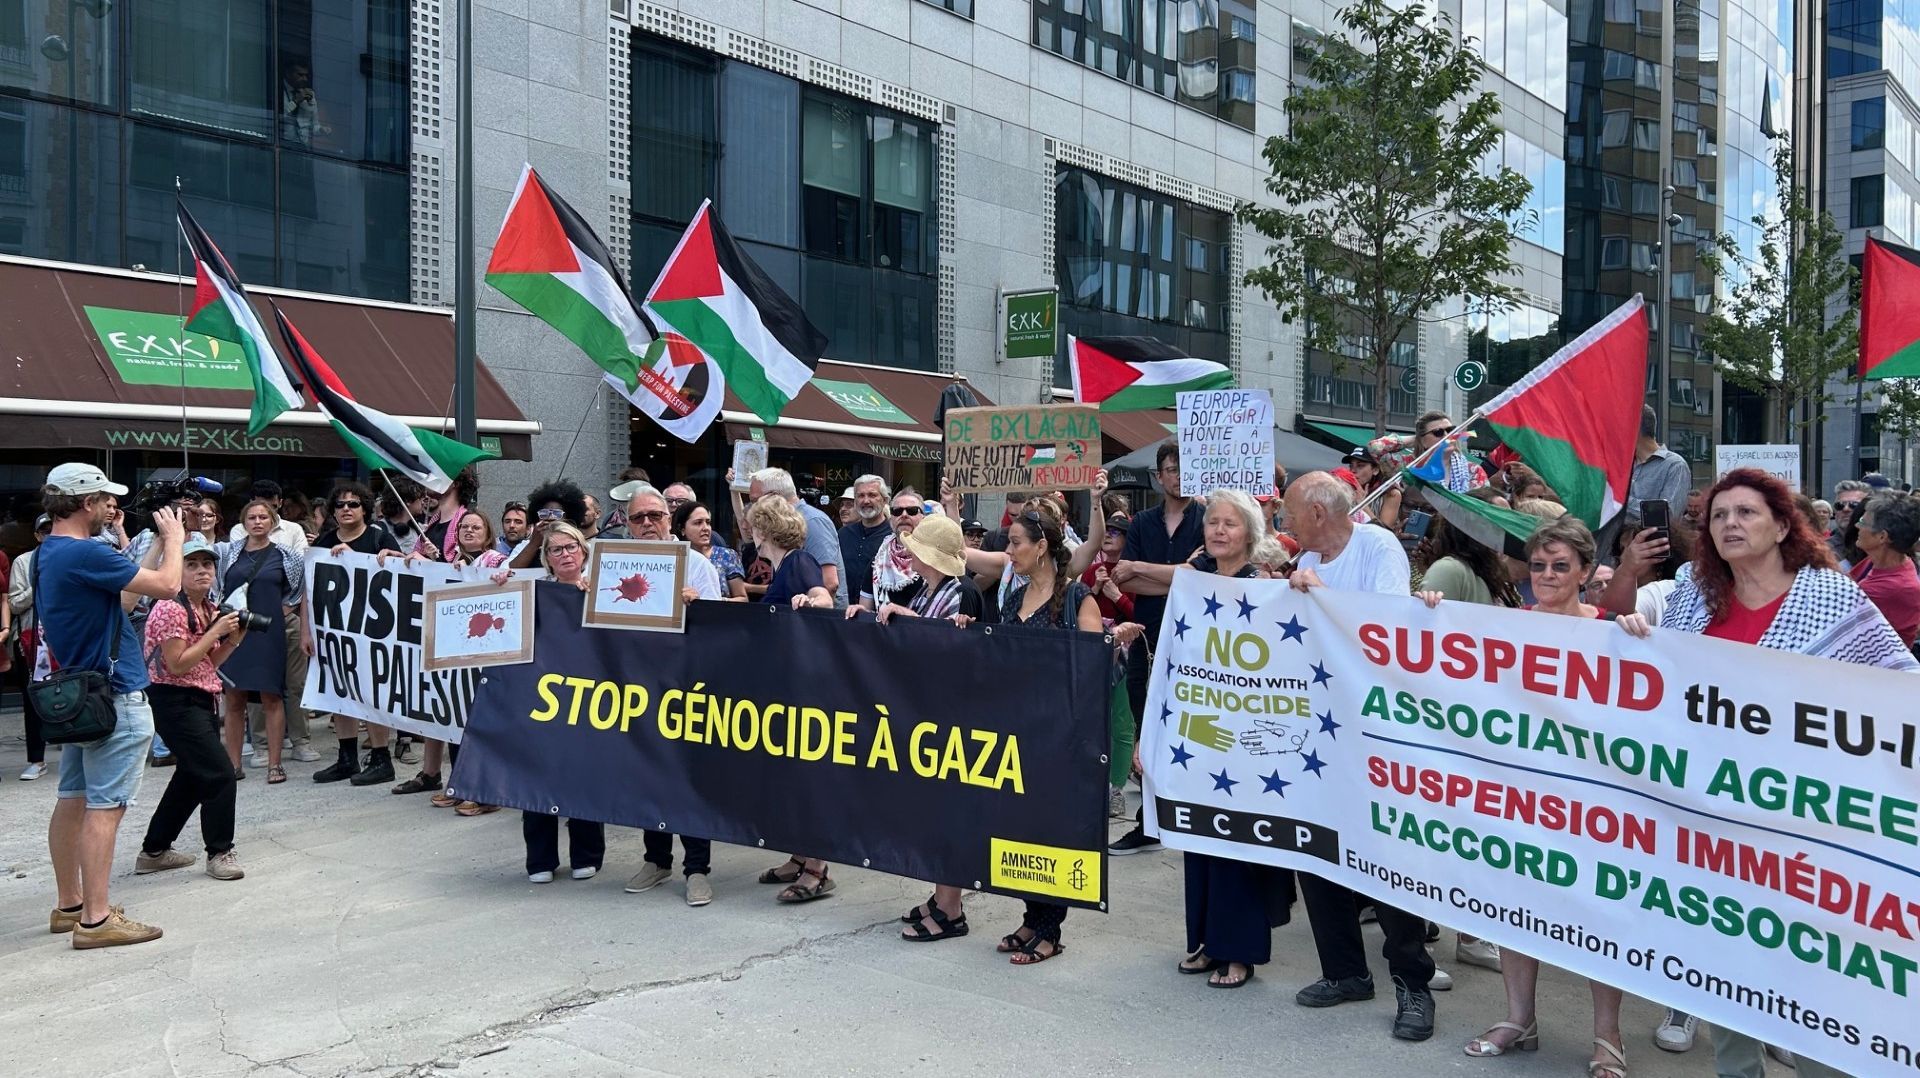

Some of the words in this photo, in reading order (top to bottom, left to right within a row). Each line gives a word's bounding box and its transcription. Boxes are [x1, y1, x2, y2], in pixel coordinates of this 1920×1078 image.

[210, 363, 239, 371] ready
[1464, 368, 1474, 383] S
[1180, 392, 1250, 410] L'EUROPE
[1190, 410, 1223, 426] DOIT
[948, 416, 973, 442] DE
[1183, 425, 1234, 442] HONTE
[948, 445, 981, 467] UNE
[984, 443, 1026, 468] LUTTE
[1182, 447, 1192, 456] LA
[1191, 456, 1262, 470] COMPLICE
[947, 467, 979, 488] UNE
[1183, 471, 1194, 482] DU
[1200, 469, 1264, 485] GÉNOCIDE
[1183, 484, 1196, 495] DES
[601, 560, 618, 570] NOT
[620, 561, 629, 570] IN
[631, 562, 645, 571] MY
[312, 561, 425, 646] RISE
[442, 606, 456, 616] UE
[457, 600, 516, 615] COMPLICE!
[1204, 626, 1270, 671] NO
[316, 629, 365, 705] FOR
[1176, 663, 1261, 688] ASSOCIATION
[1266, 677, 1308, 691] WITH
[1358, 623, 1664, 711] SUSPEND
[1684, 683, 1772, 735] the
[1174, 681, 1312, 718] GENOCIDE
[530, 673, 649, 732] STOP
[657, 682, 859, 767] GÉNOCIDE
[867, 705, 899, 773] À
[909, 722, 1025, 795] GAZA
[1361, 685, 1688, 788] ASSOCIATION
[1367, 755, 1656, 855] SUSPENSION
[1001, 851, 1057, 873] AMNESTY
[1001, 868, 1057, 885] INTERNATIONAL
[1346, 848, 1443, 902] European
[1449, 887, 1619, 960] Coordination
[1626, 948, 1655, 971] of
[1662, 955, 1861, 1046] Committees
